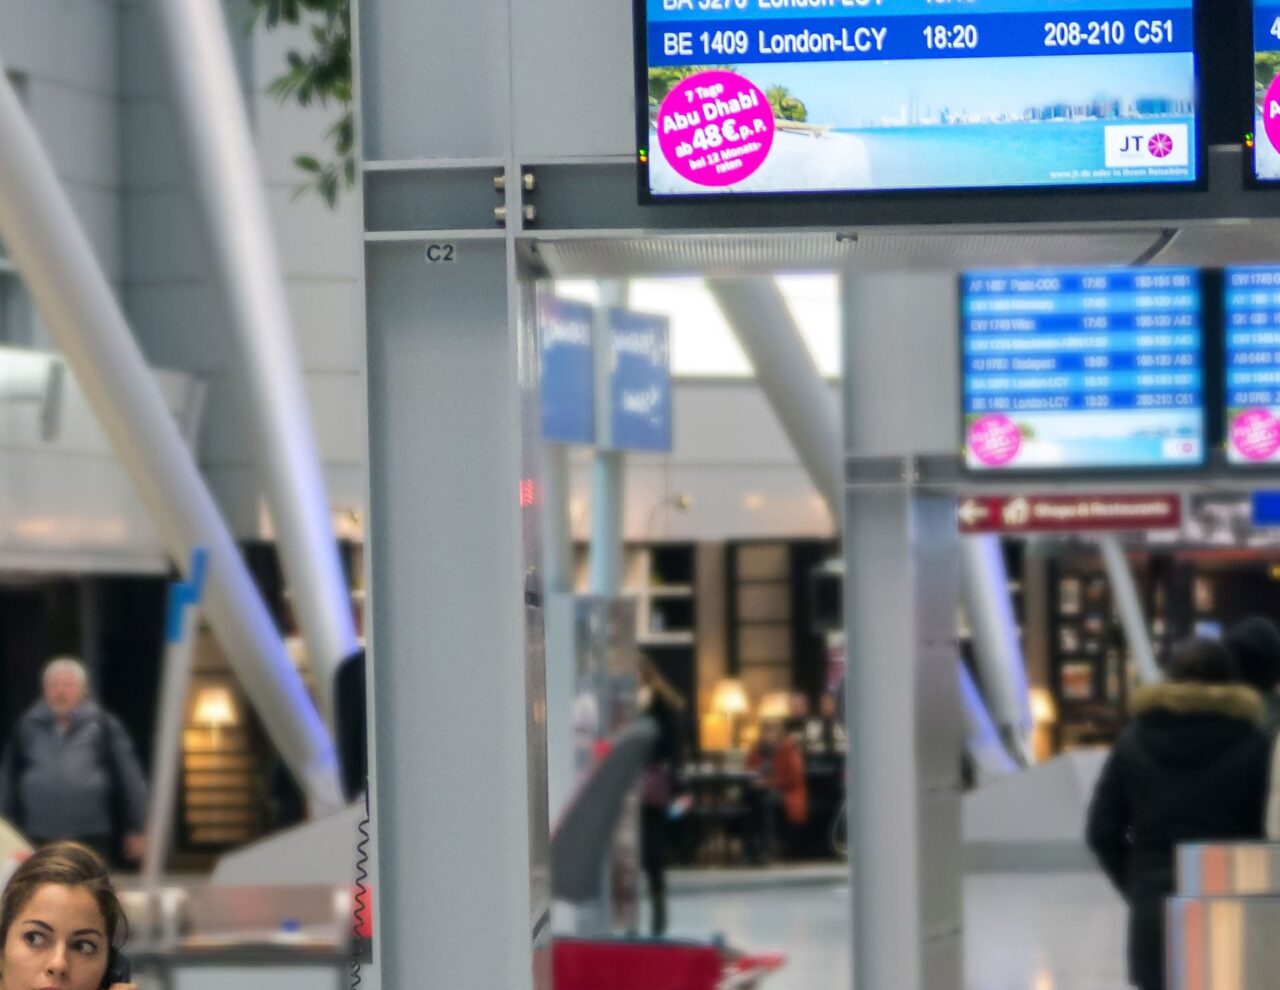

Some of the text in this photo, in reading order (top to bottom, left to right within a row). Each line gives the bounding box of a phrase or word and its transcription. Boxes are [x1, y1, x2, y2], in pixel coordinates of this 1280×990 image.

[664, 20, 1172, 56] BE 1409 London-LCY 18:20 208-210 C51
[684, 83, 724, 103] 7 Tage
[663, 89, 759, 134] Abu Dhabi
[675, 141, 693, 158] ab
[1120, 136, 1144, 152] JT
[427, 244, 453, 261] C2
